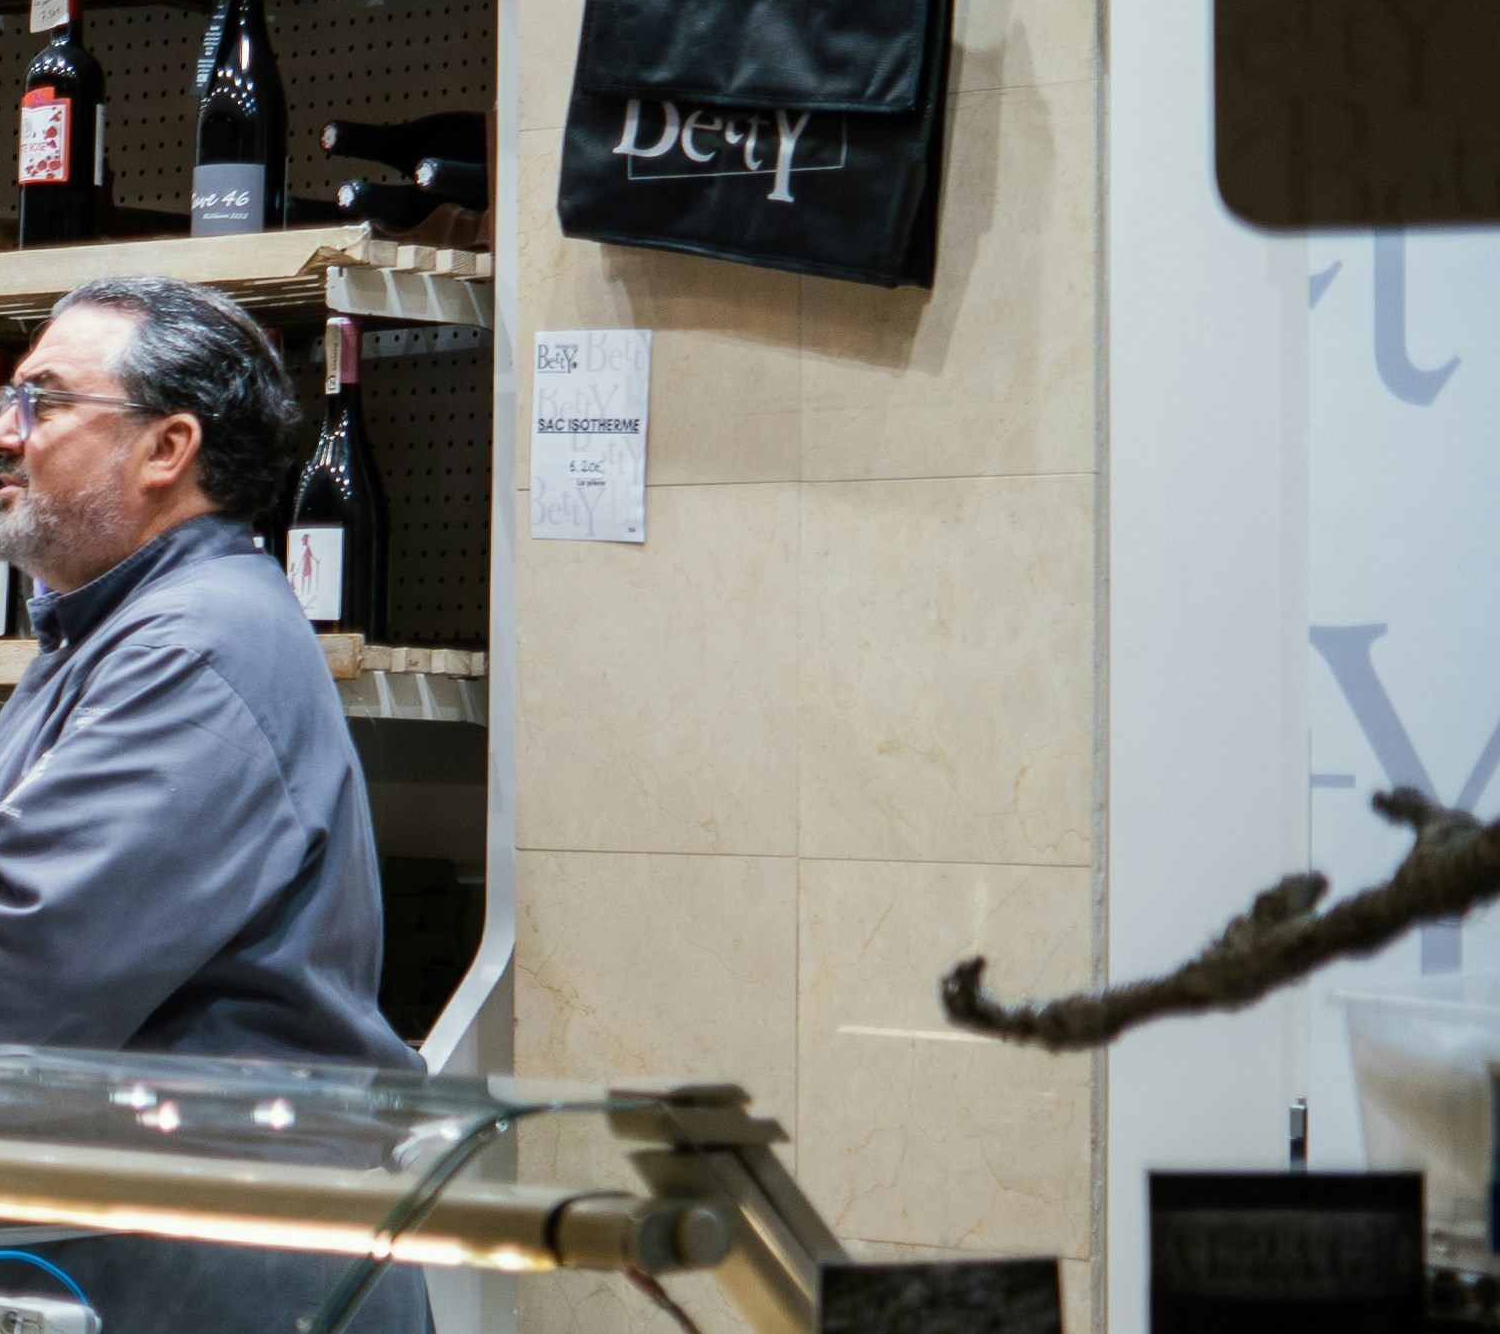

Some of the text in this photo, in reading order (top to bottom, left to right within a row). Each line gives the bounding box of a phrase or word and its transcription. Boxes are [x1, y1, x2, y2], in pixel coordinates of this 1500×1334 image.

[222, 189, 251, 206] 46
[537, 418, 640, 433] SAC ISOTHERME
